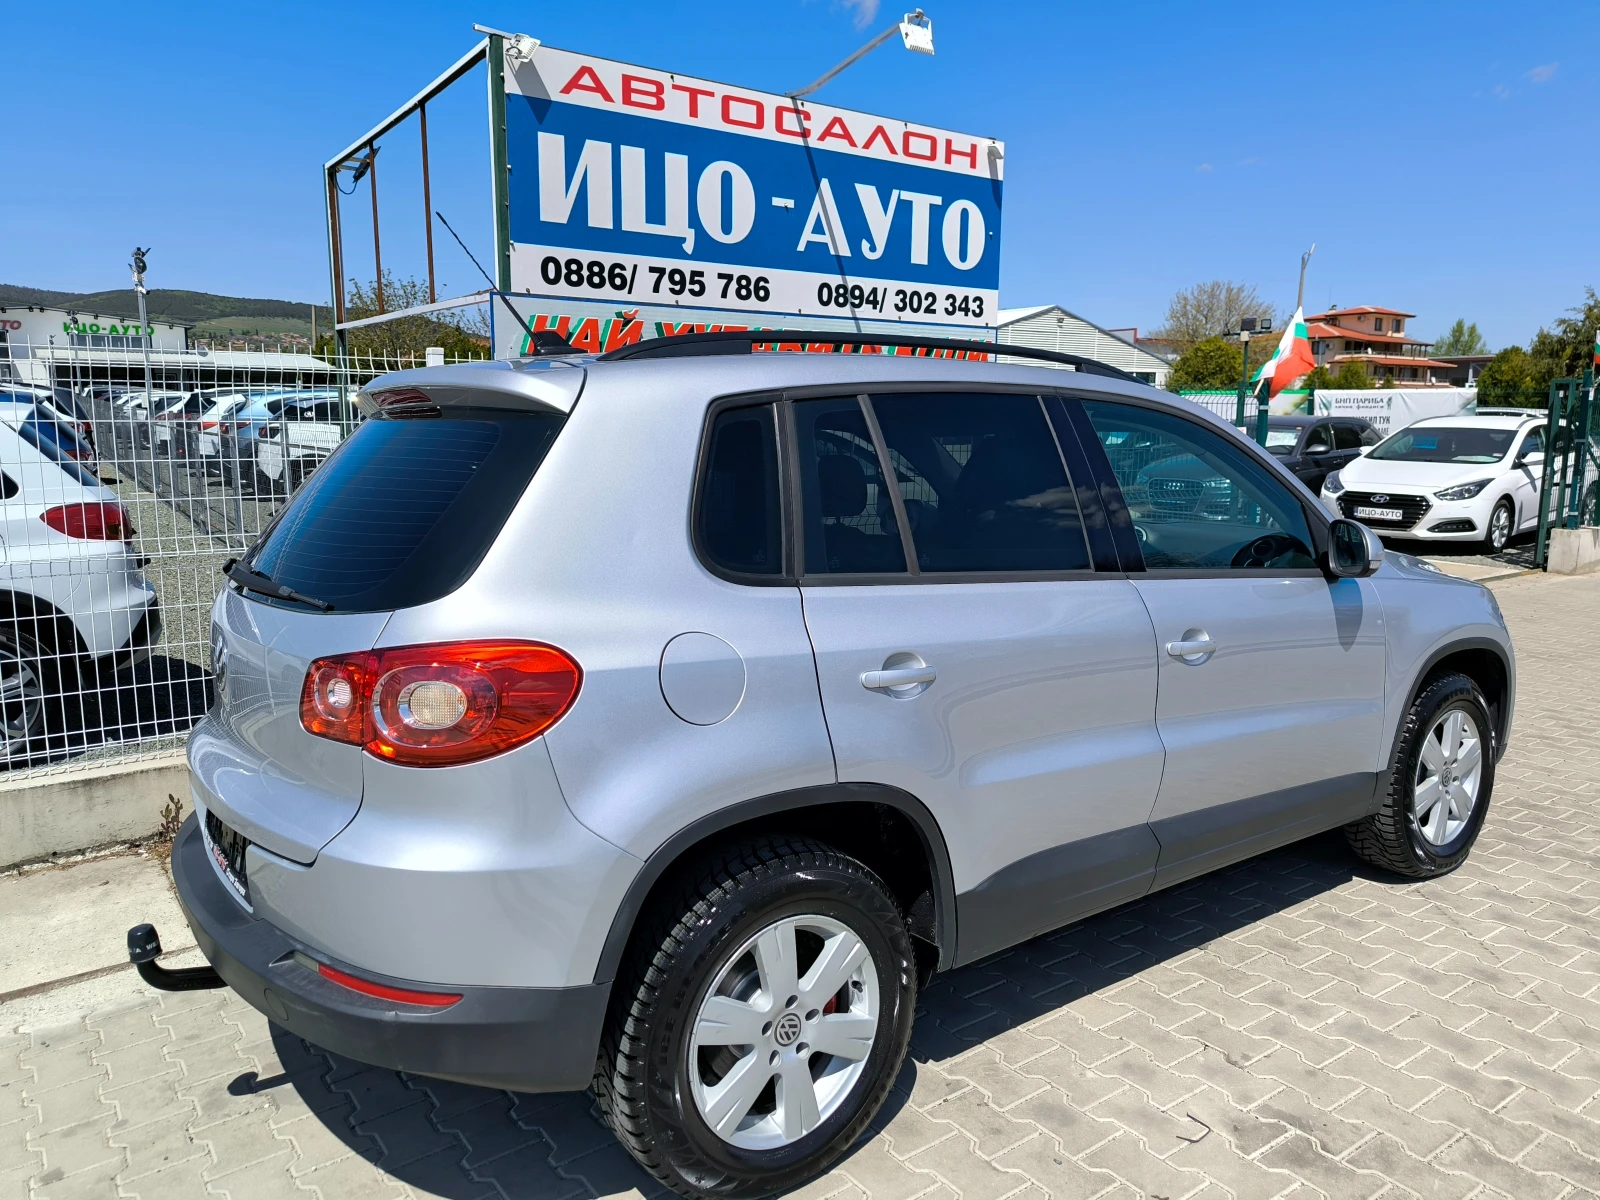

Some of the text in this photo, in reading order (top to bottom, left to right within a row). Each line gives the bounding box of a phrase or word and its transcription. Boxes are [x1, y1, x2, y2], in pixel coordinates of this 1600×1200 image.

[559, 65, 978, 170] АВТОСАЛОН
[540, 255, 771, 303] 0886/ 795 786
[817, 281, 985, 319] 0894/ 302 343
[1358, 508, 1402, 518] ИЦО-АУТО
